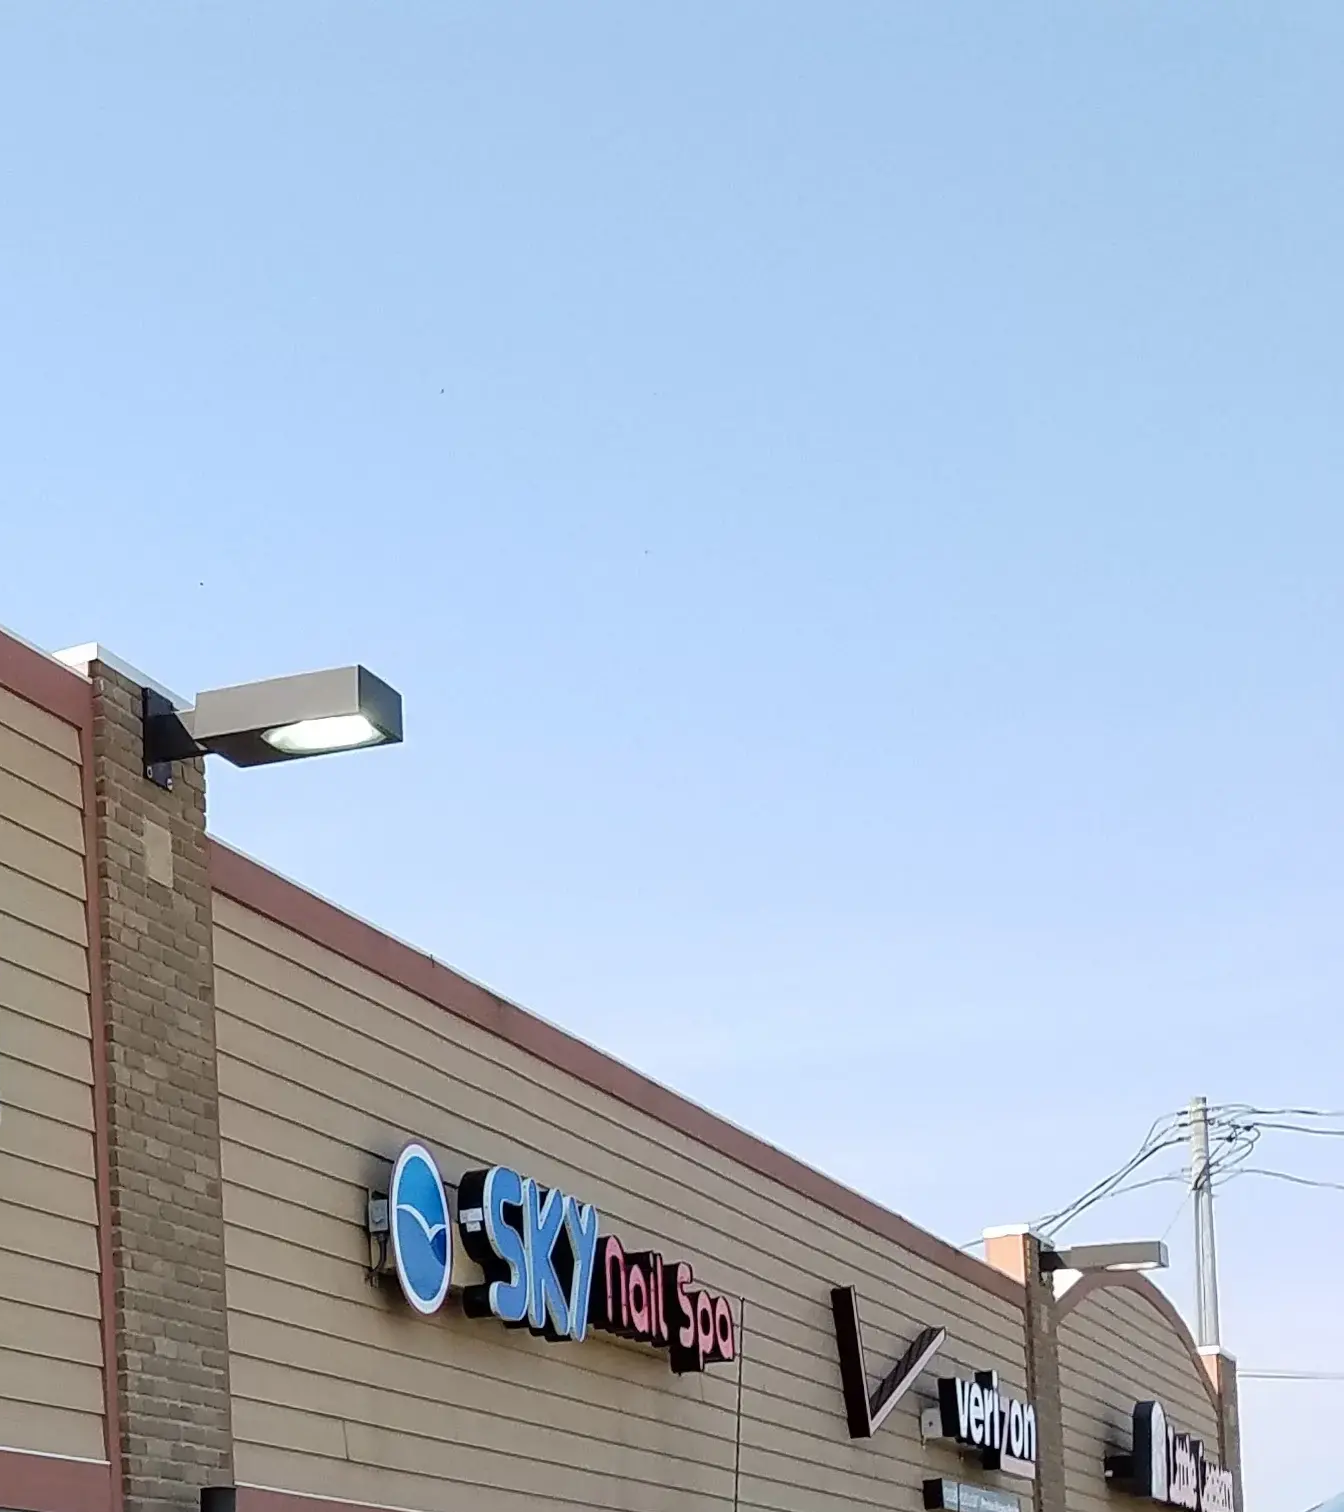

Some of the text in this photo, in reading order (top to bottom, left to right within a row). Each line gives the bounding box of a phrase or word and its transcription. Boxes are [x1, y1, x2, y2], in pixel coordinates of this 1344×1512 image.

[482, 1165, 599, 1343] SKY
[677, 1261, 736, 1372] Spa
[955, 1369, 1036, 1480] verizon
